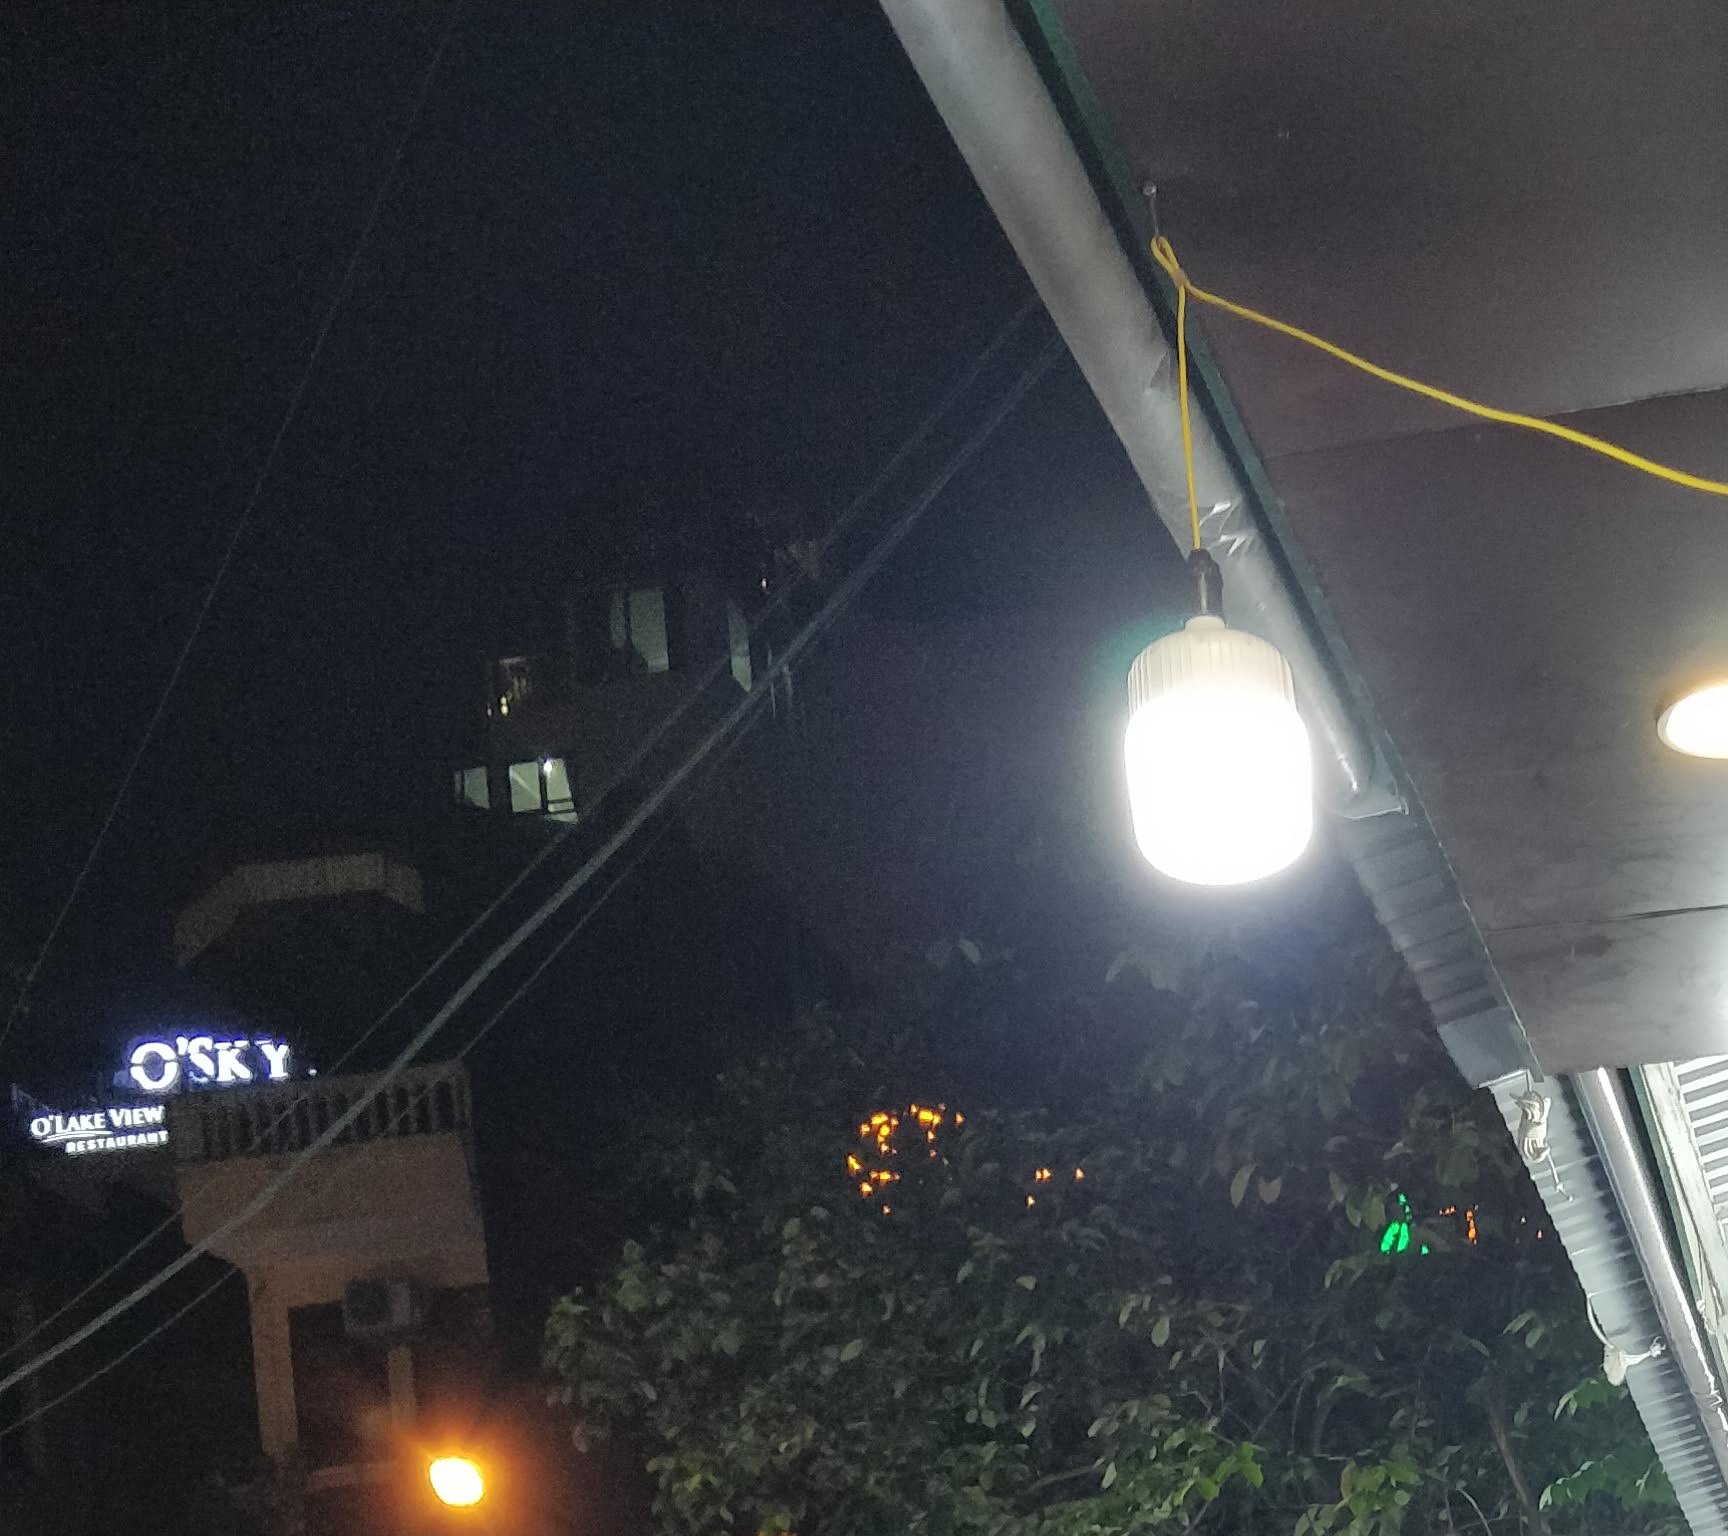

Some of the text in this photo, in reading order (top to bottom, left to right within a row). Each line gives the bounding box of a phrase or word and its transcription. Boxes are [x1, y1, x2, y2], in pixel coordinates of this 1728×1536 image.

[130, 1036, 290, 1090] O'SKY
[30, 1105, 165, 1137] O'LAKE VIEW
[65, 1130, 169, 1153] RESTAURANT
